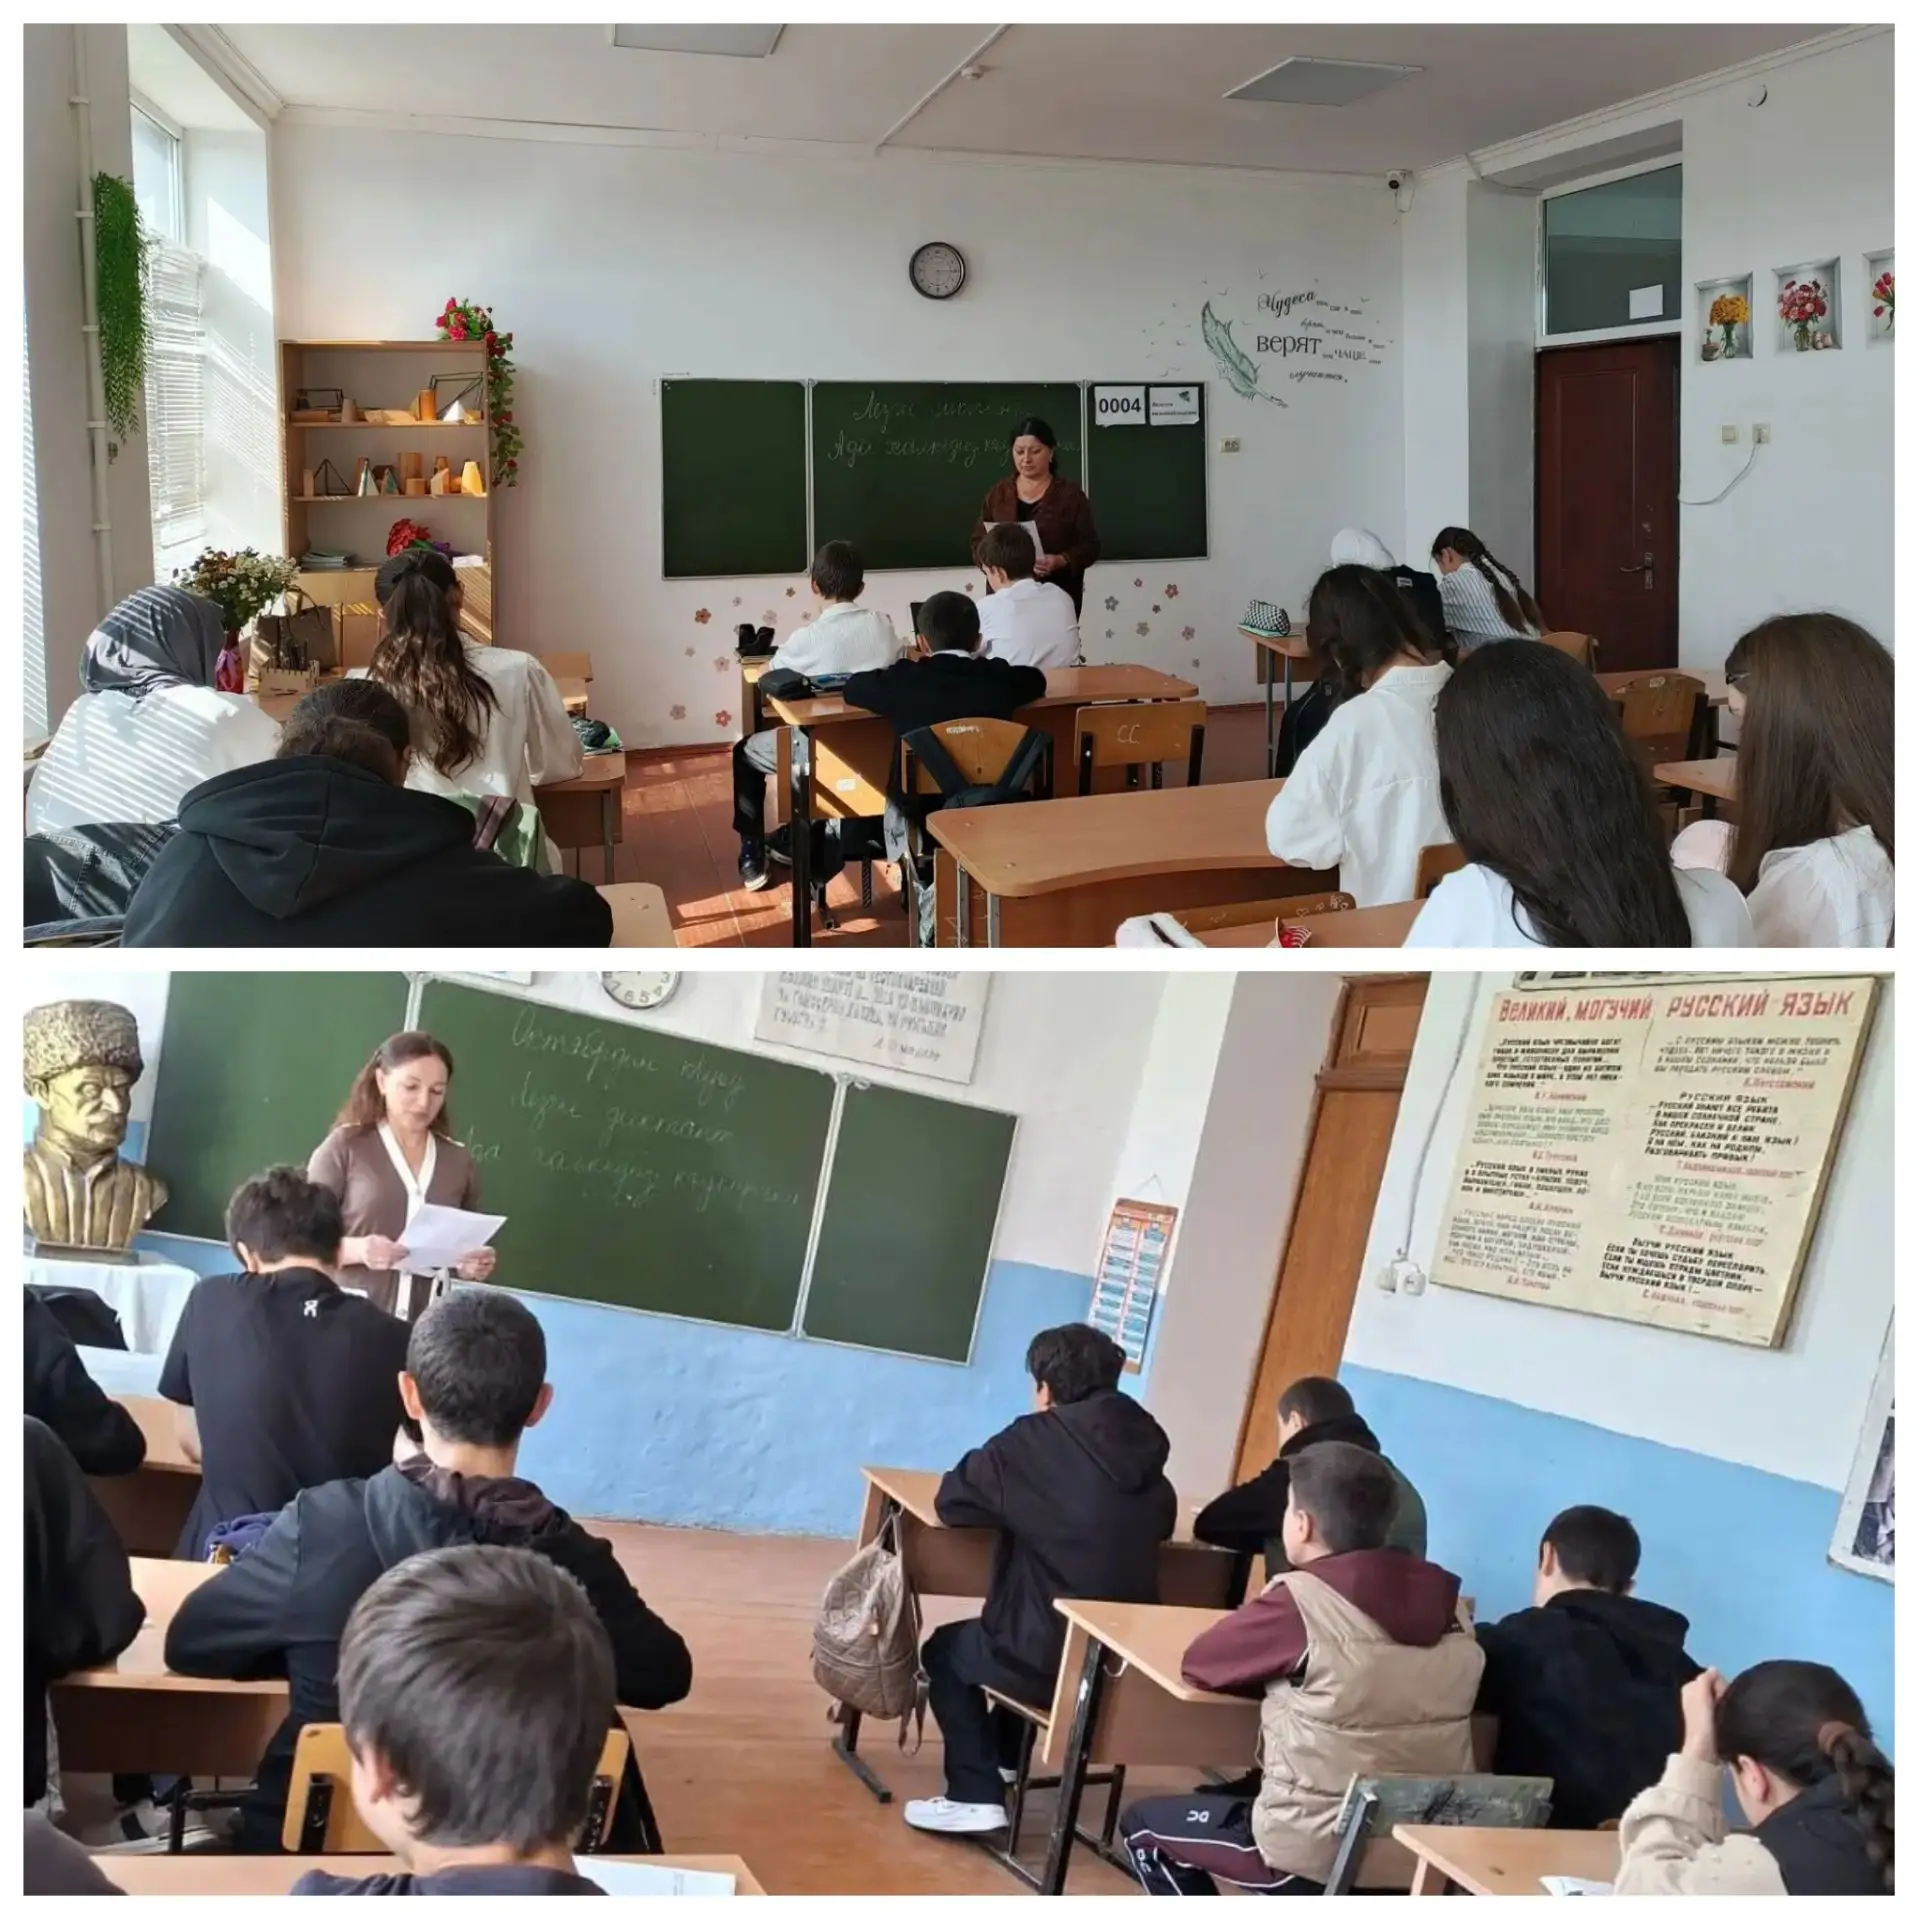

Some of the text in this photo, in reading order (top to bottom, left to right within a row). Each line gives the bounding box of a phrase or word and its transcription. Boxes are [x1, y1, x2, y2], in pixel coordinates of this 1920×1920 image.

[1257, 290, 1316, 318] Чудеса
[1257, 335, 1322, 357] верят
[1099, 398, 1141, 413] 0004
[611, 981, 622, 992] 7
[653, 986, 662, 997] 4
[624, 990, 634, 1002] 6
[640, 990, 650, 1003] 5
[1575, 994, 1653, 1021] МОГУЧИЙ
[1667, 989, 1770, 1018] РУССКИЙ
[1778, 991, 1855, 1017] ЯЗЫК
